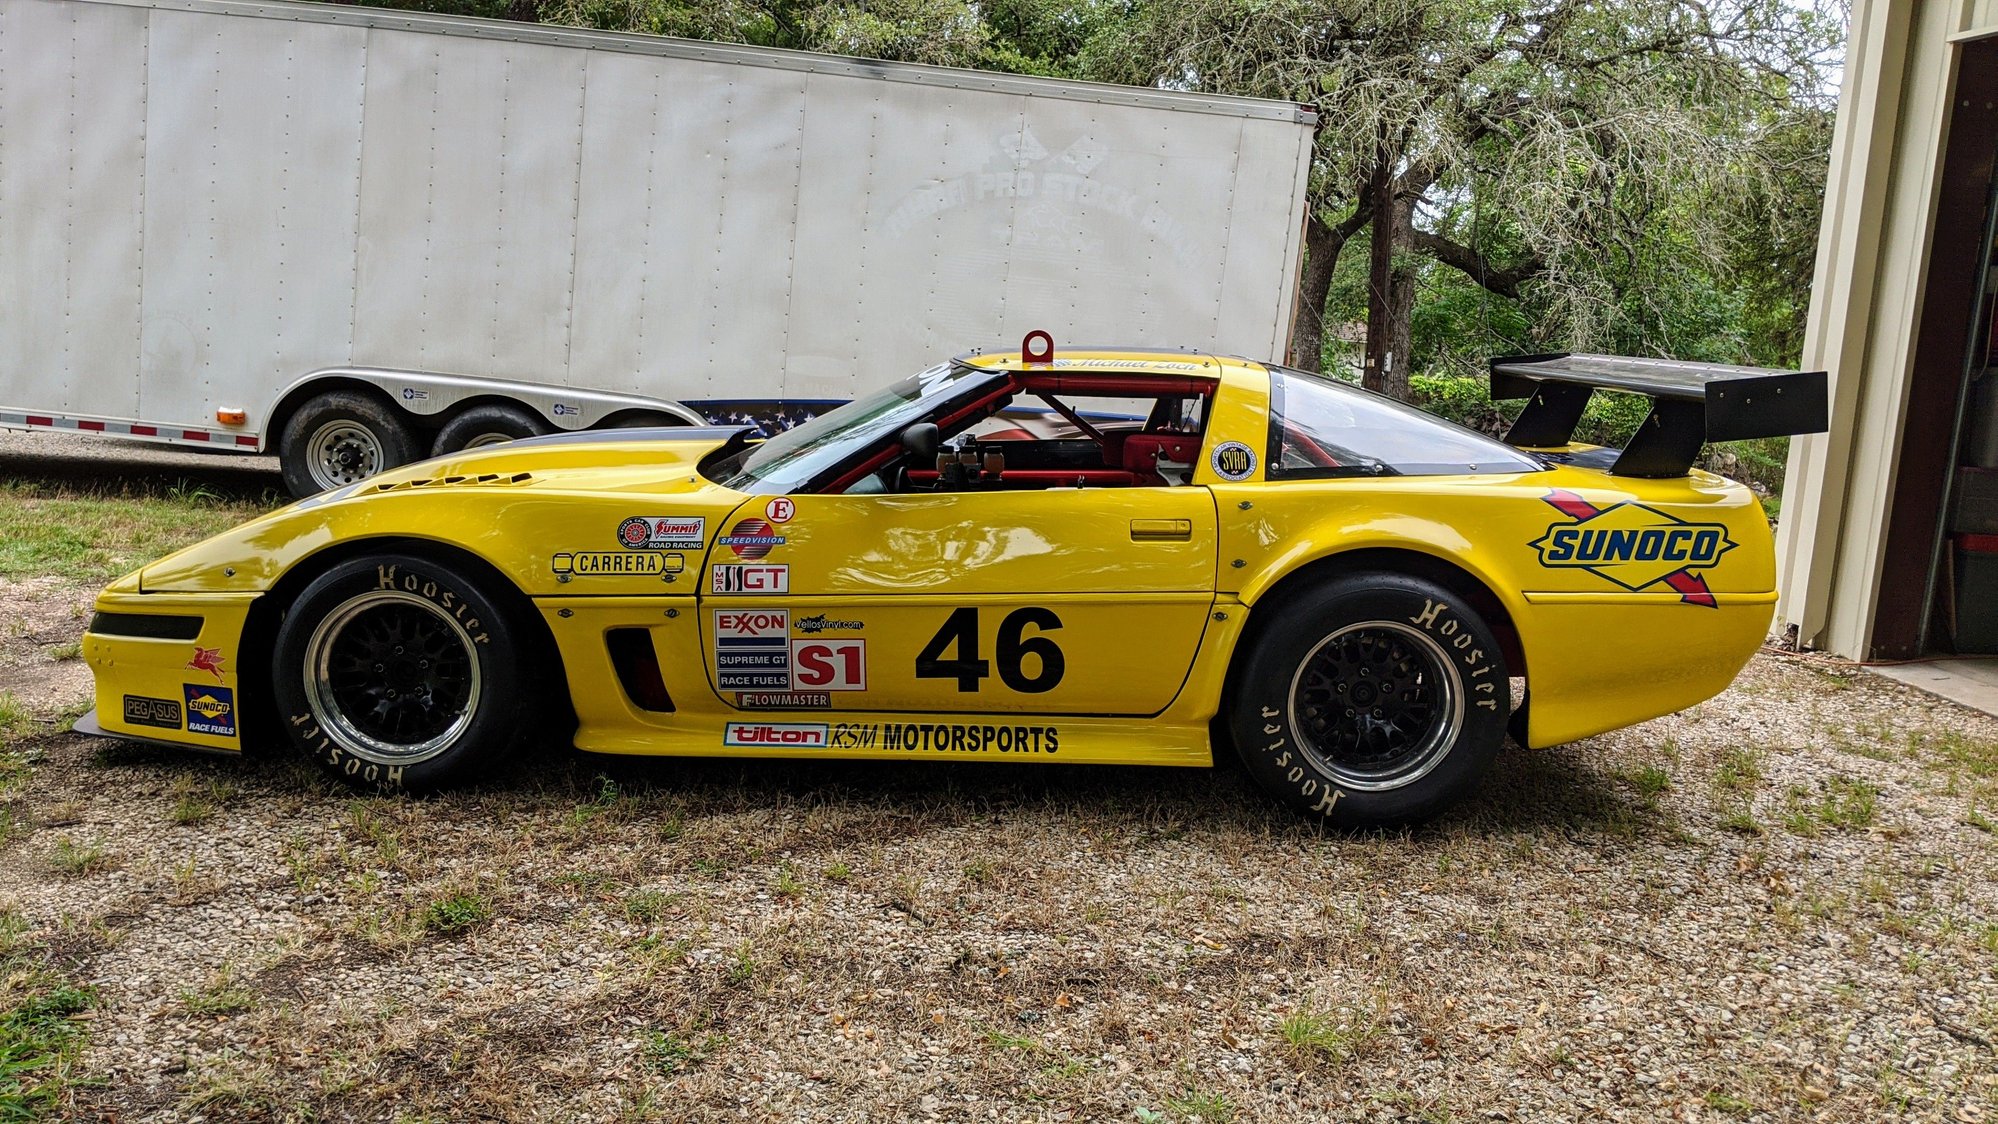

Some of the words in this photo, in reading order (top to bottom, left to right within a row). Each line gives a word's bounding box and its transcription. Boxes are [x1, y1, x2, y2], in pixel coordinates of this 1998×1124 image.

[1072, 358, 1149, 369] Michael
[1222, 451, 1247, 470] SVRA
[772, 500, 790, 520] E
[1547, 529, 1720, 561] SUNOCO
[580, 555, 657, 572] CARRERA
[743, 568, 786, 589] GT
[373, 564, 491, 646] Hoosier
[719, 612, 785, 635] EXXON
[915, 606, 1066, 694] 46
[1409, 598, 1498, 712] Hoosier
[719, 656, 770, 665] SUPREME
[772, 656, 787, 665] GT
[797, 645, 862, 686] S1
[720, 676, 750, 685] RACE
[753, 677, 788, 685] FUELS
[128, 700, 178, 720] PEGASUS
[190, 700, 229, 713] SUNOCO
[742, 694, 827, 707] FLOWMASTER
[188, 722, 210, 732] RACE
[210, 724, 235, 735] FUELS
[733, 726, 822, 743] tilton
[830, 723, 879, 749] RSM
[883, 723, 1060, 754] MOTORSPORTS
[291, 712, 412, 788] Hoosier
[1261, 705, 1347, 816] Hoosier
